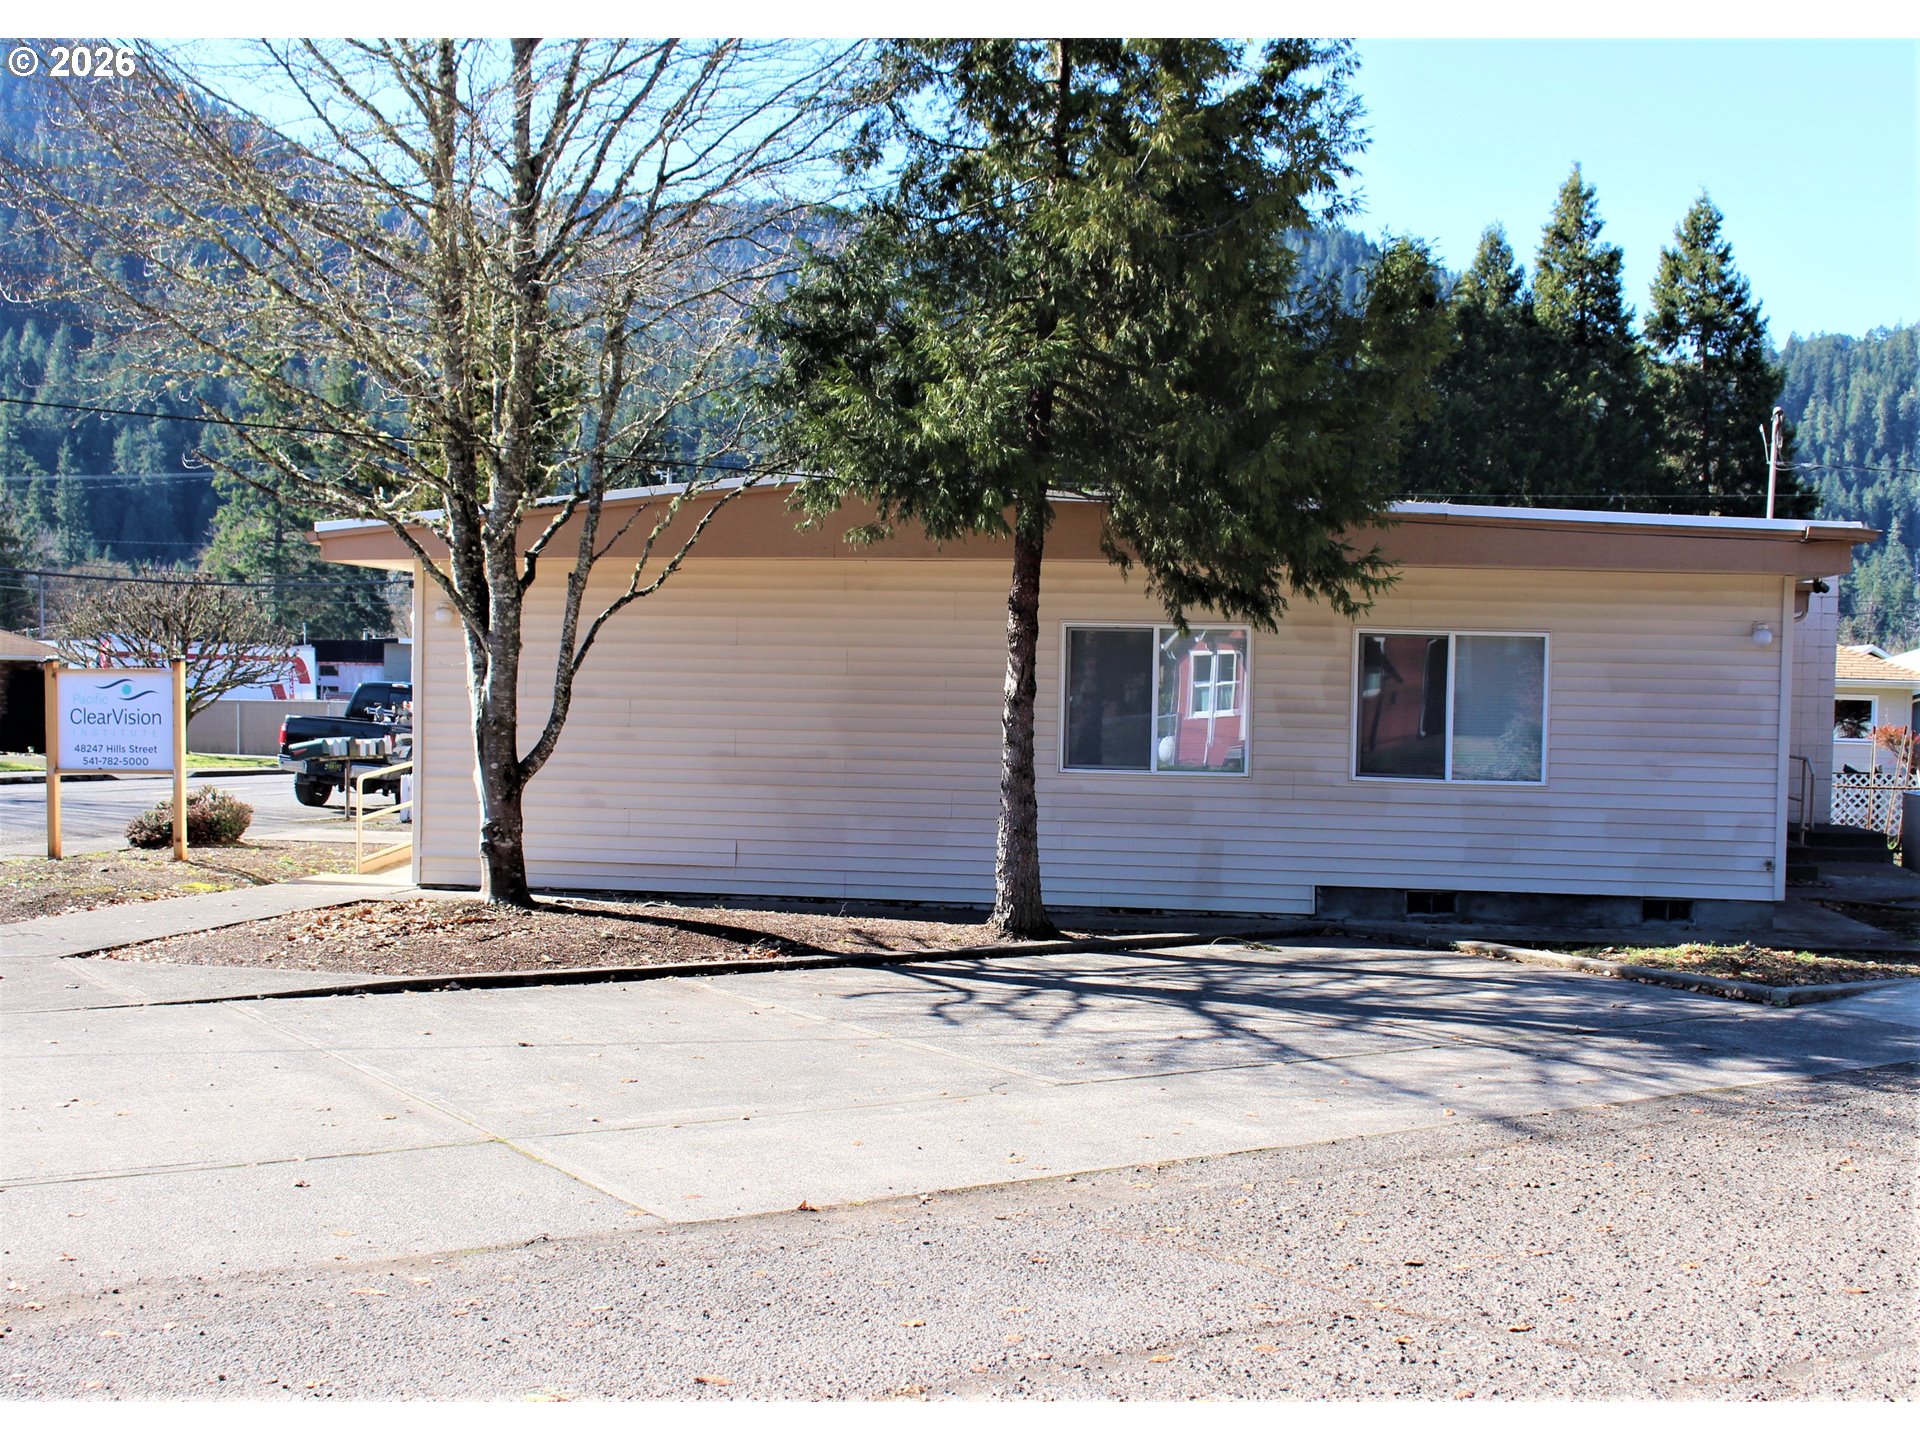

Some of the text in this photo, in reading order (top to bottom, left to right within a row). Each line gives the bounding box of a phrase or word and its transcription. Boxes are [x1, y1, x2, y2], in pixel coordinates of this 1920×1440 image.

[73, 693, 108, 704] Pacific
[70, 708, 161, 725] ClearVision
[73, 729, 158, 737] INSTITUTE
[74, 744, 157, 753] 48247 Hills Street
[83, 757, 149, 765] 541-782-5000
